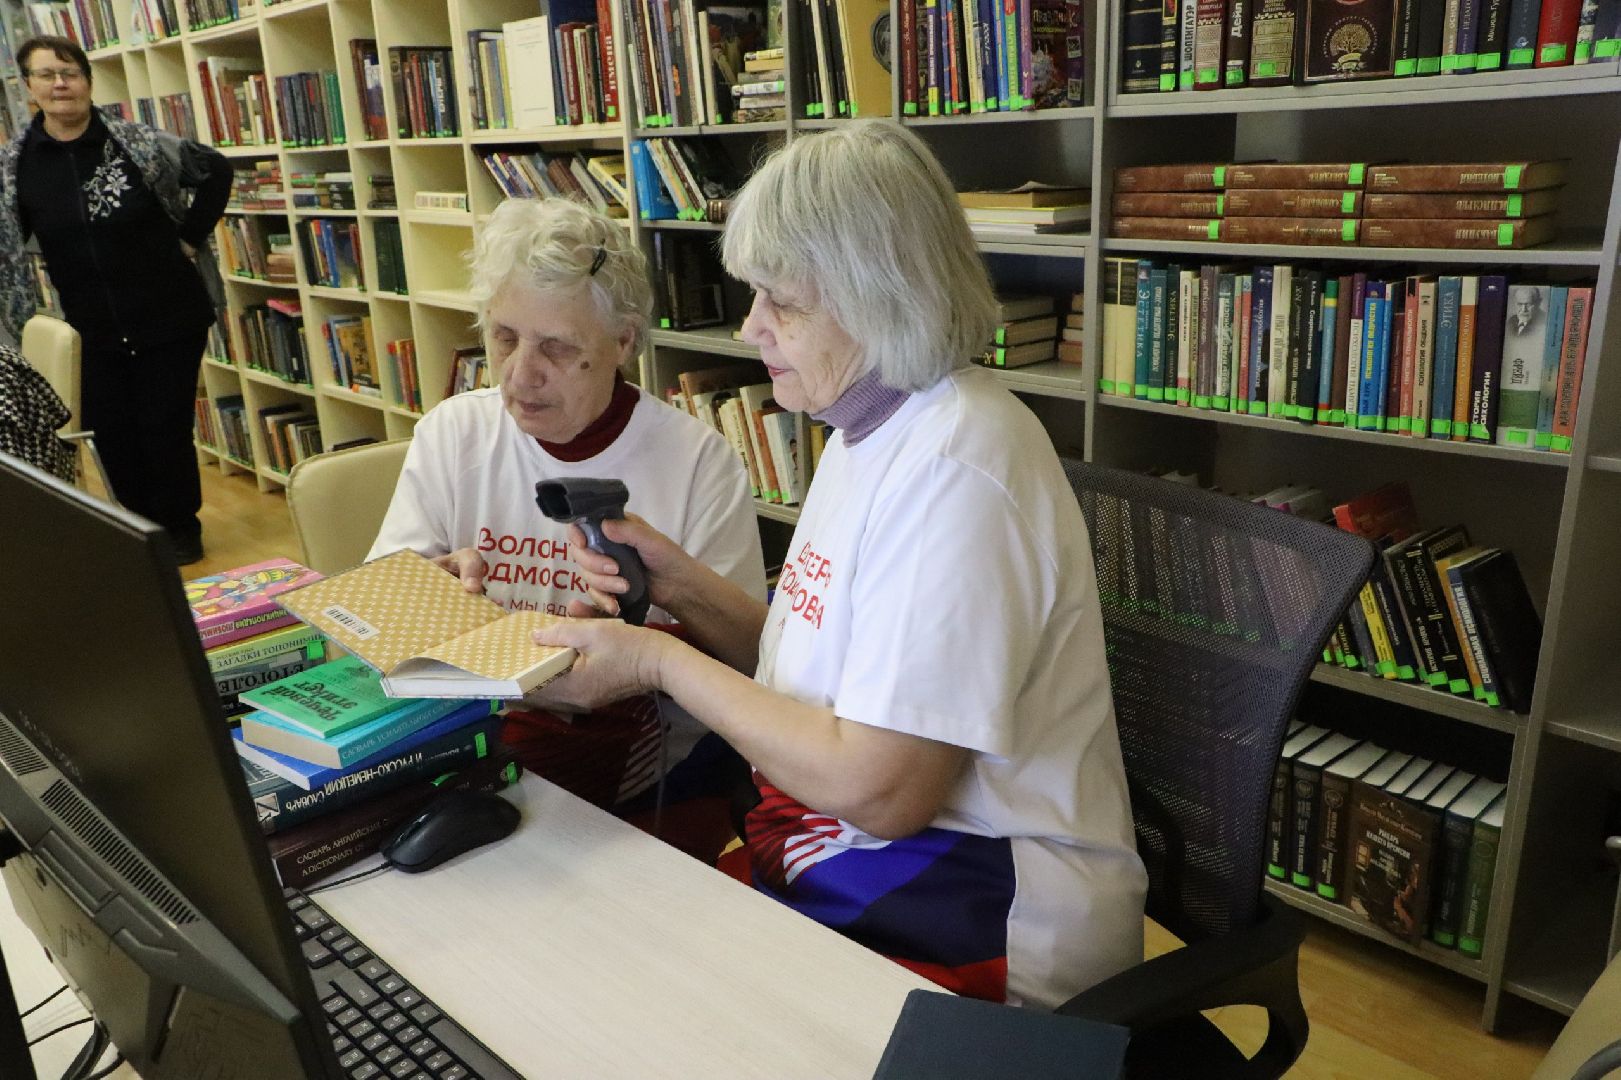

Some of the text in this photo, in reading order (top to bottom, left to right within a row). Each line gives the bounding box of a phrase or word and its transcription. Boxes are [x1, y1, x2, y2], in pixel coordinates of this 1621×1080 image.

[1184, 4, 1195, 60] ШОПЕНГАУЭР
[1231, 2, 1242, 38] Дейл
[1136, 289, 1151, 358] ЭСТЕТИКА
[1167, 290, 1178, 342] ЭСТЕТИКА
[1441, 291, 1455, 329] ЭТИКА
[1350, 321, 1361, 379] ПСИХОЛОГИЯ
[1418, 349, 1427, 387] ПСИХОЛОГИЯ
[1472, 390, 1482, 425] СТОРИЯ
[1481, 371, 1492, 426] СИХОЛОГИИ
[478, 527, 576, 563] ВОЛОН
[482, 559, 590, 594] ДМОСК
[510, 599, 538, 612] МЫ
[201, 622, 234, 639] ЛЮБИМЫ
[1454, 586, 1492, 684] СОЦИАЛЬНАЯ ПСИХОЛОГИЯ
[217, 651, 260, 668] ЗАГАДКИ
[260, 680, 358, 722] Речевой этикет
[342, 735, 376, 760] СЛОВАРЬ
[324, 754, 414, 796] РУССКО-НЕМЕЦКИЙ
[285, 790, 325, 813] СЛОВАРЬ
[296, 823, 382, 864] СЛОВАРЬ АНГЛИЙСКИХ
